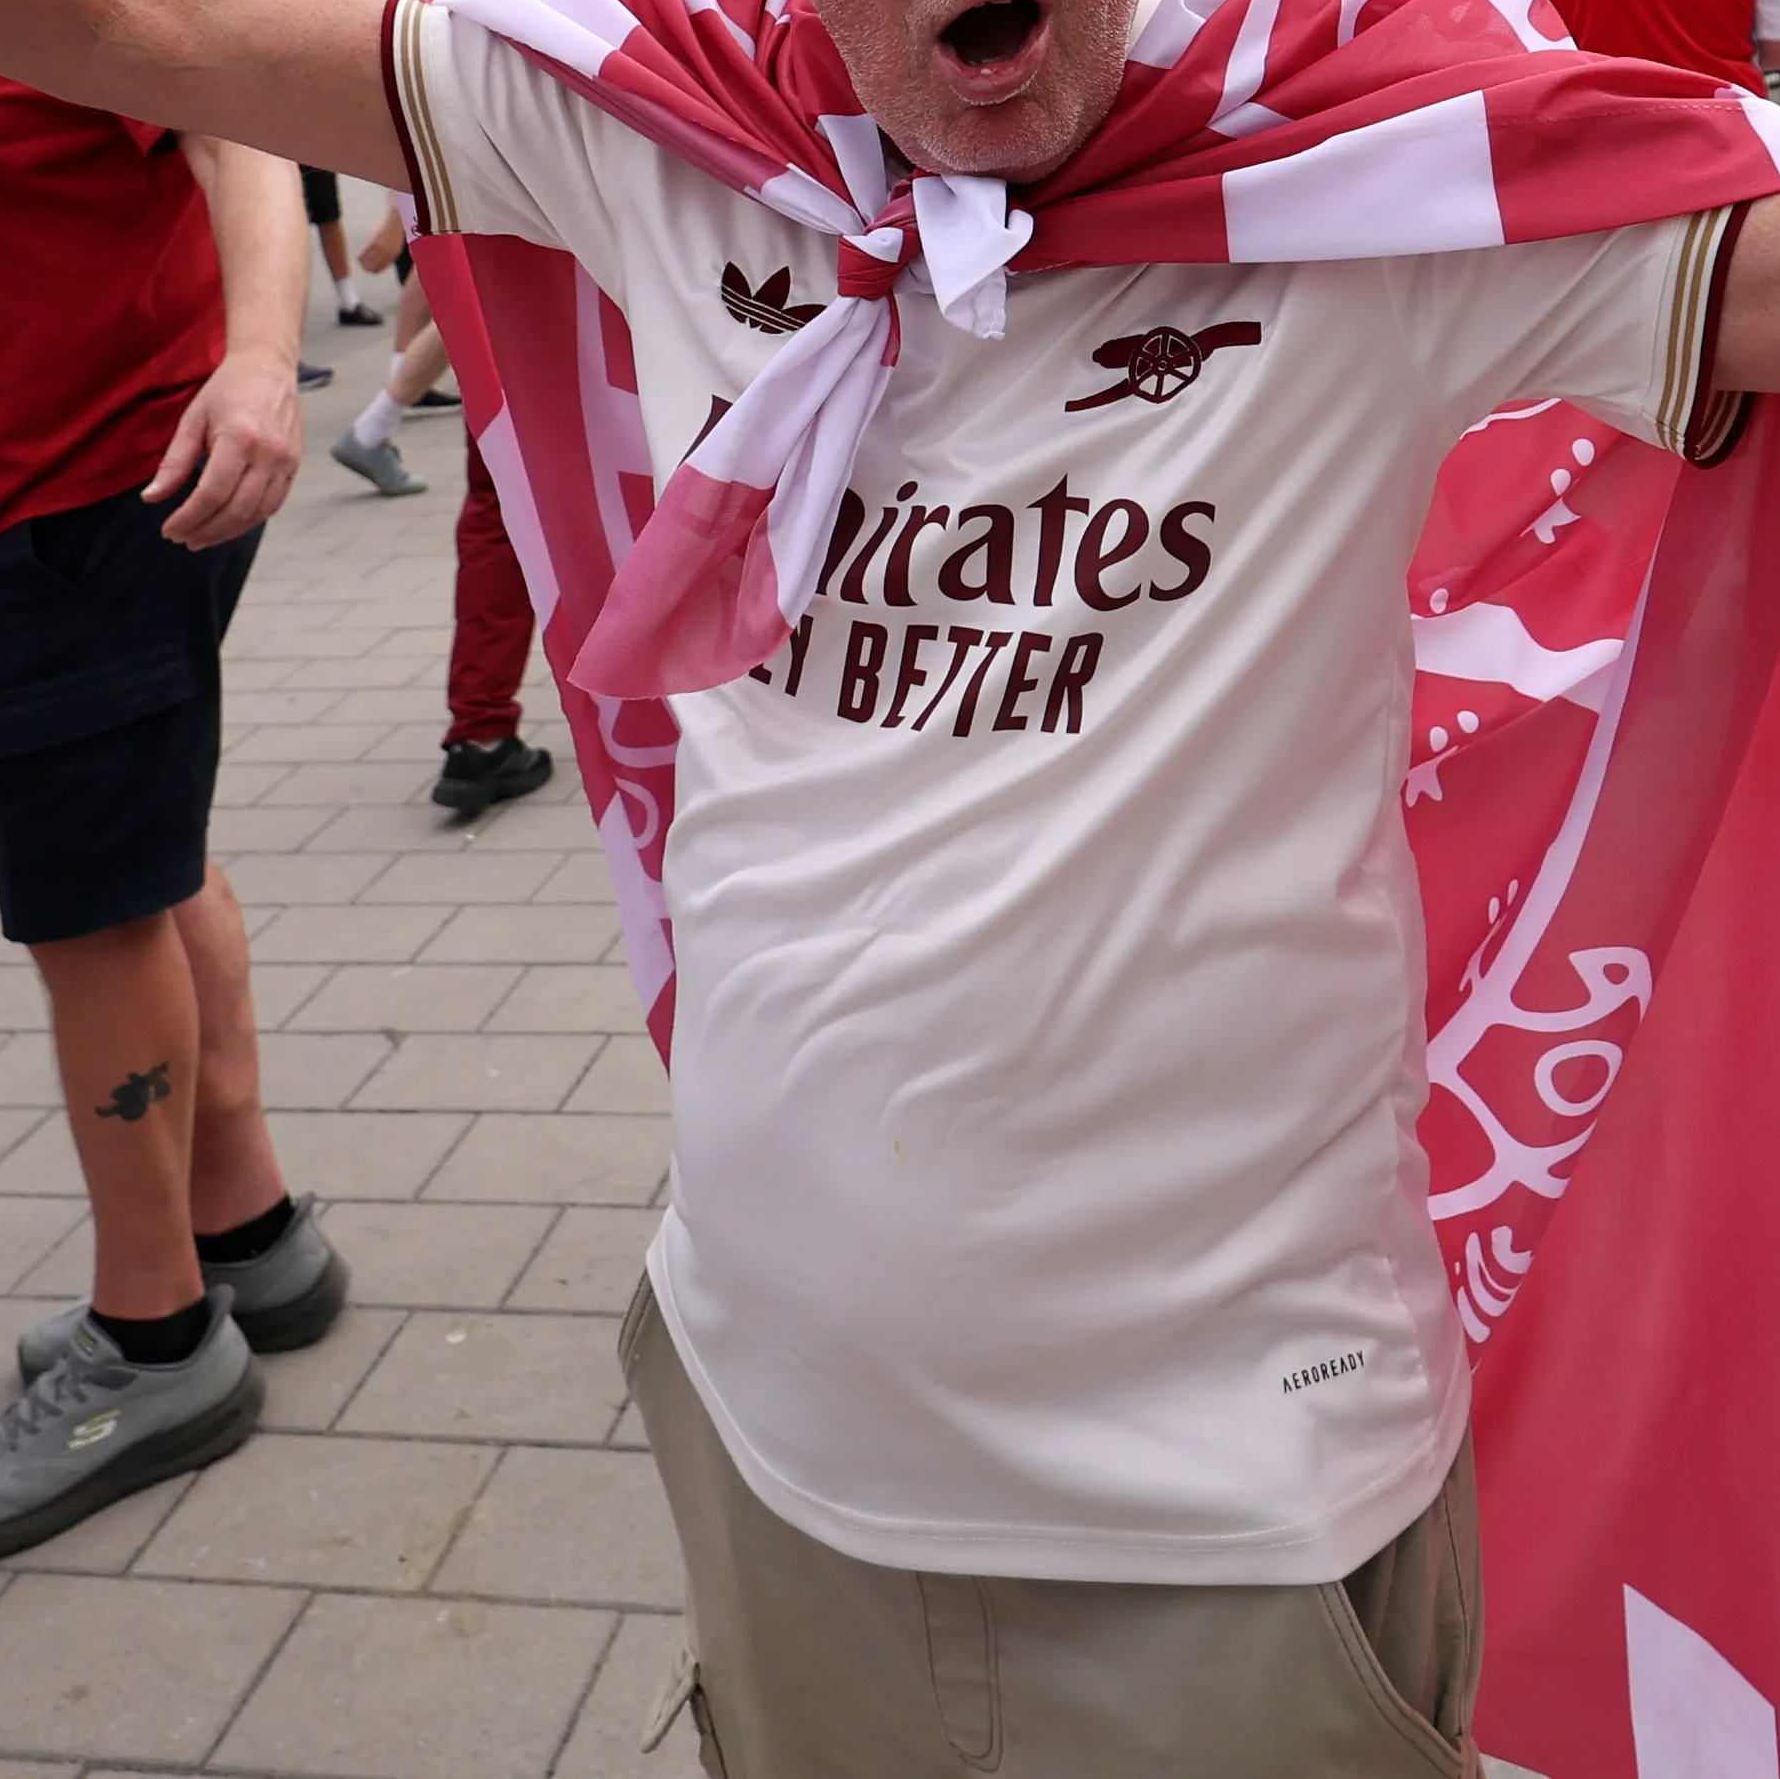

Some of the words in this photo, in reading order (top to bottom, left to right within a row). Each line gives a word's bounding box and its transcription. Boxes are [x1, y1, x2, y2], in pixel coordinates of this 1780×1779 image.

[816, 473, 1218, 612] irates
[837, 620, 1105, 737] BETTER
[1282, 1350, 1366, 1394] AEROREADY
